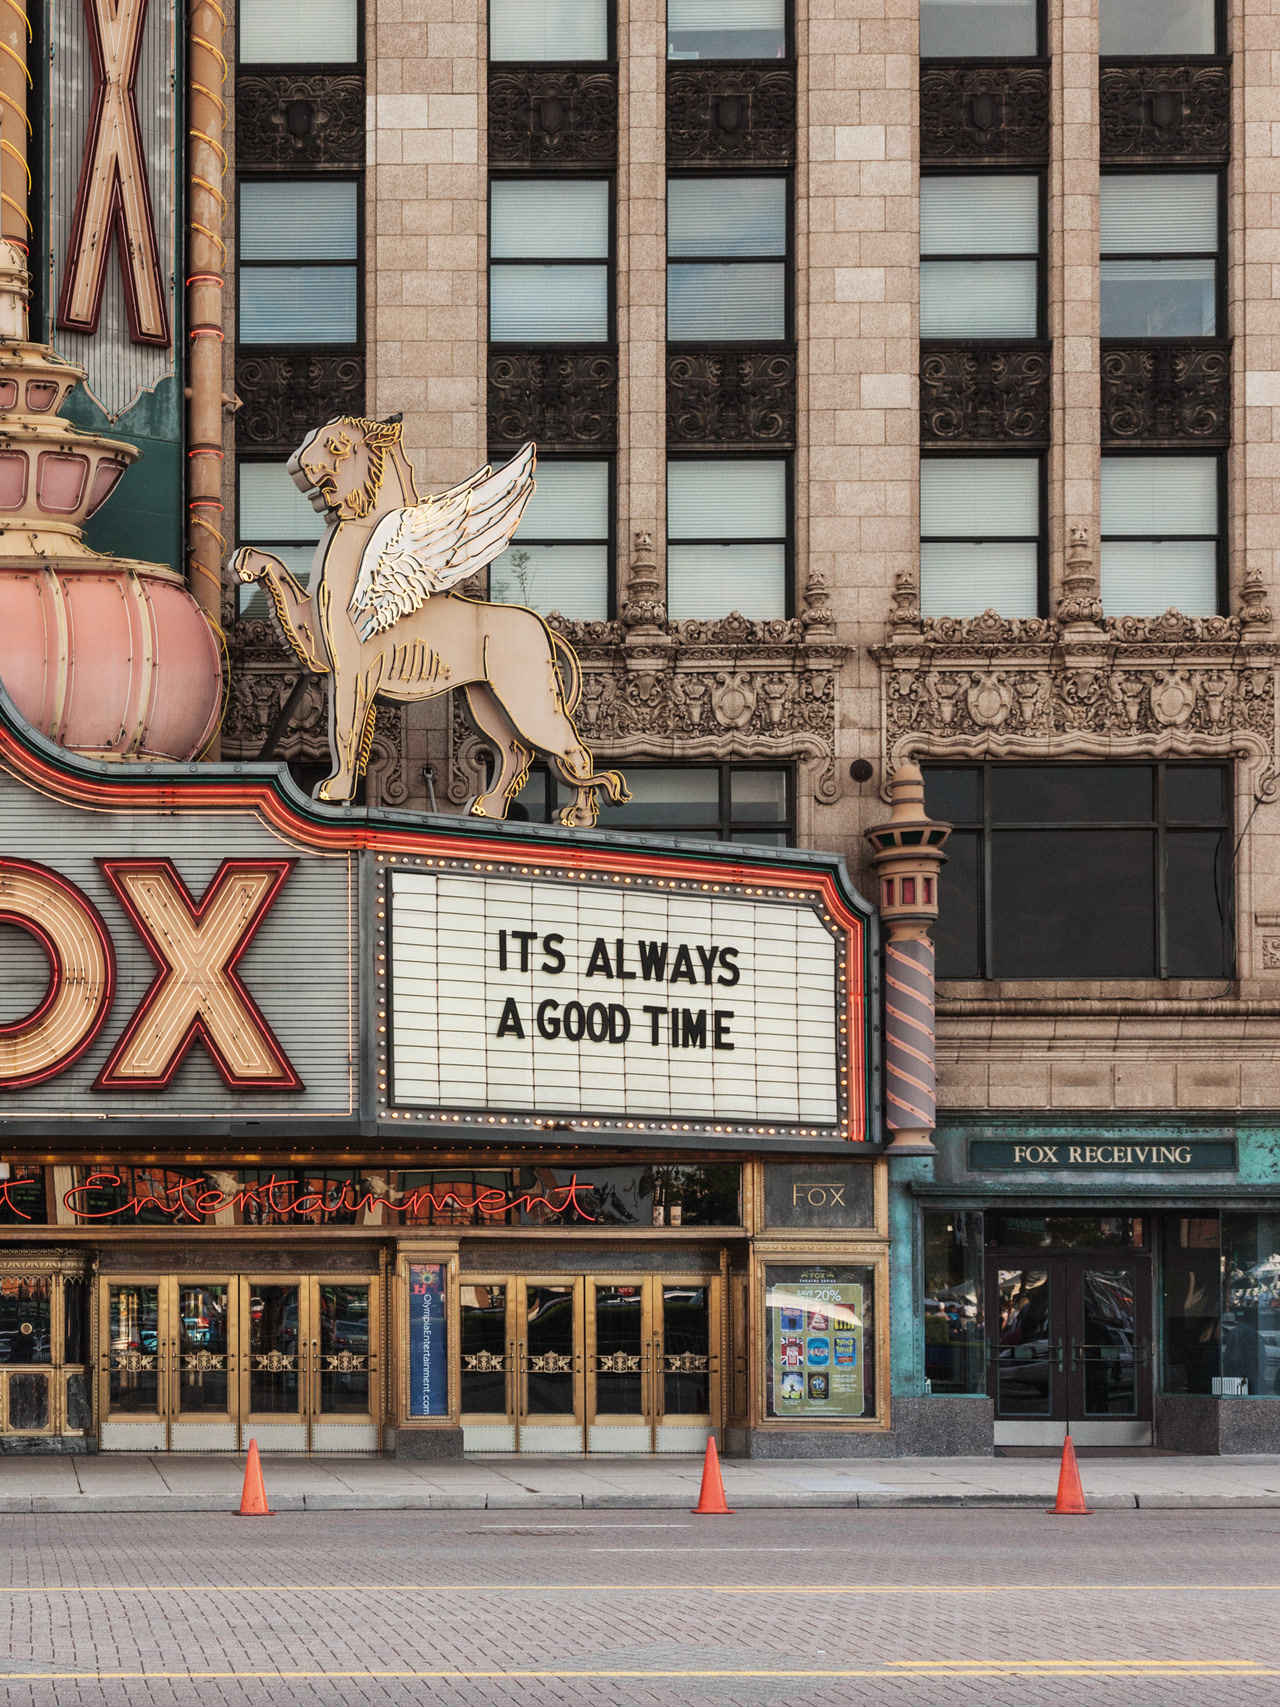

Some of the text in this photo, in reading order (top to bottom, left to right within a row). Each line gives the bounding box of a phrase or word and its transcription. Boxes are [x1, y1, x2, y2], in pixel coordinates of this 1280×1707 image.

[498, 929, 741, 987] ITS ALWAYS
[496, 997, 735, 1050] A GOOD TIME
[1013, 1145, 1192, 1164] FOX RECEIVING
[64, 1173, 595, 1222] Entertainment
[793, 1184, 846, 1207] FOX
[796, 1289, 842, 1302] SAVE 20%
[422, 1293, 432, 1415] OlympiaEntertainment.com
